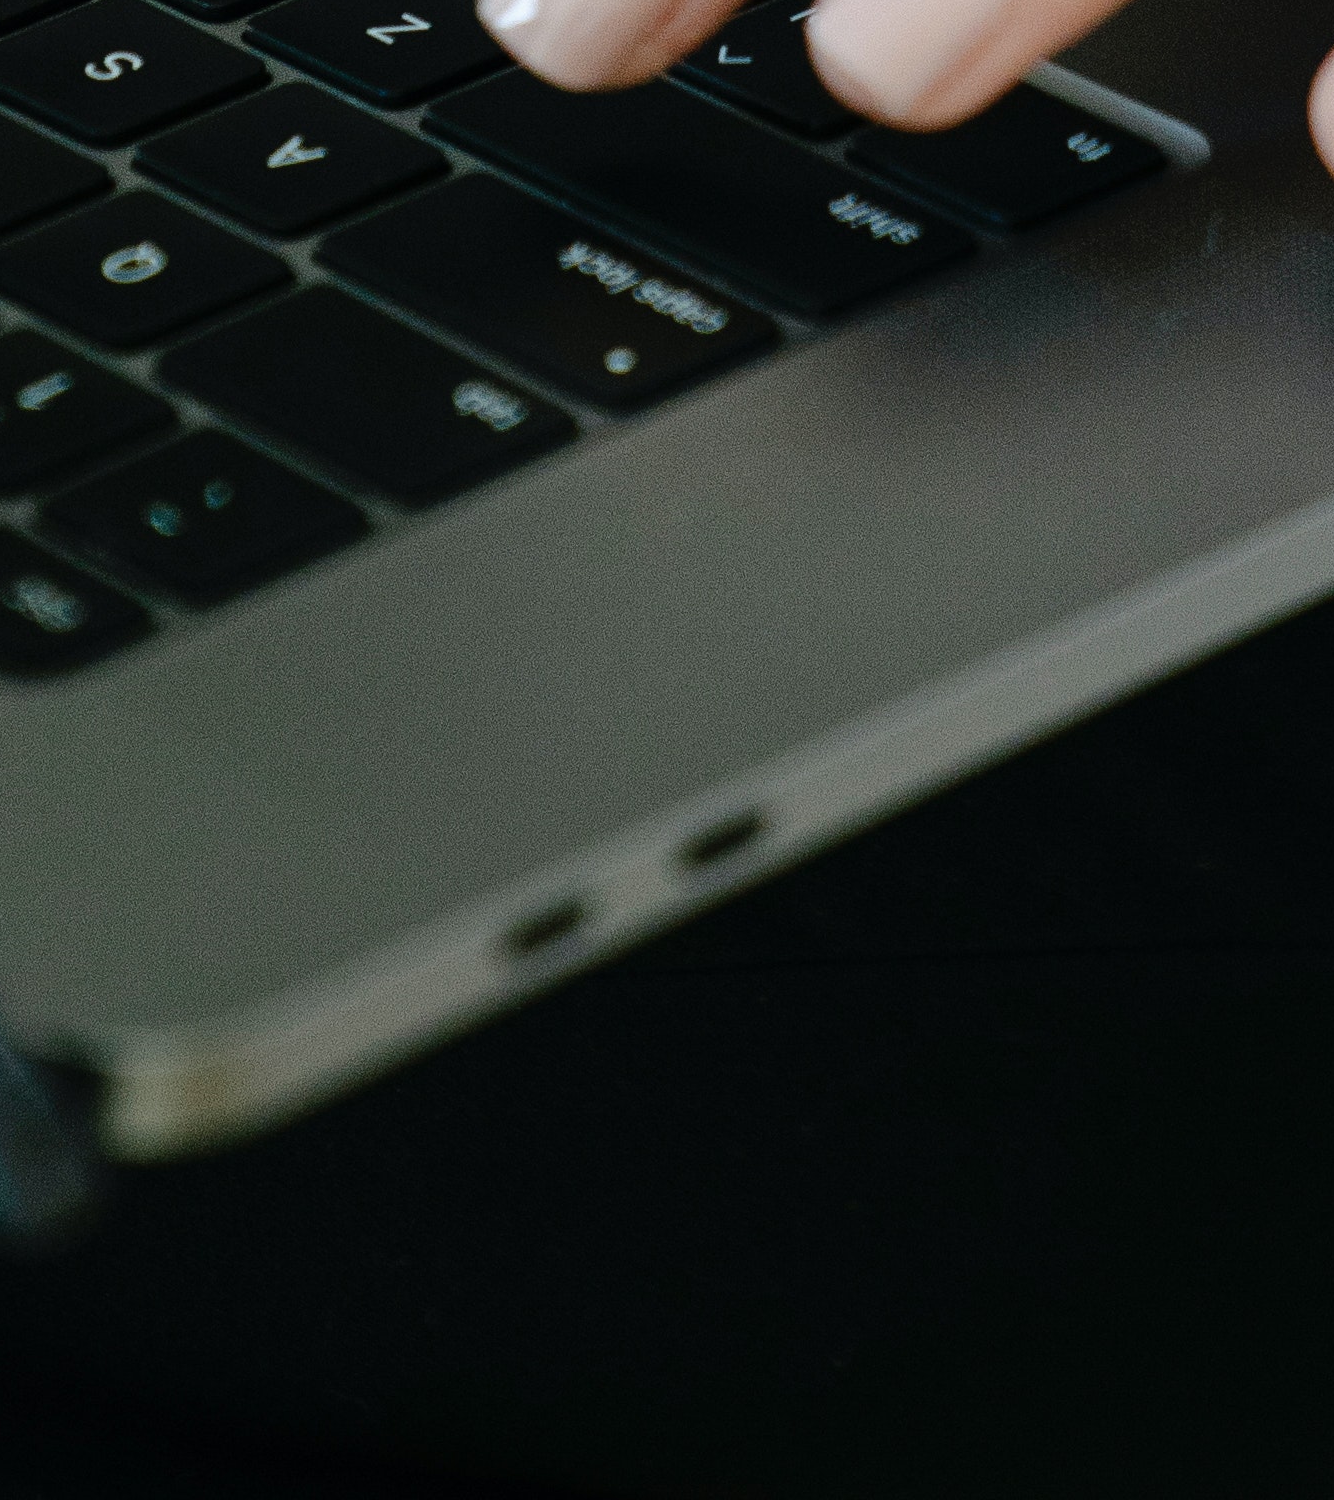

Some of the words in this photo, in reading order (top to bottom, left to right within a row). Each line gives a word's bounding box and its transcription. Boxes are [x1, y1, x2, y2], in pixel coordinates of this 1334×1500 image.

[364, 11, 432, 46] Z
[83, 49, 145, 83] S
[266, 134, 327, 170] A
[1065, 131, 1114, 163] fn
[828, 192, 922, 246] shift
[100, 240, 168, 285] Q
[559, 241, 637, 295] lock
[633, 278, 730, 334] caps
